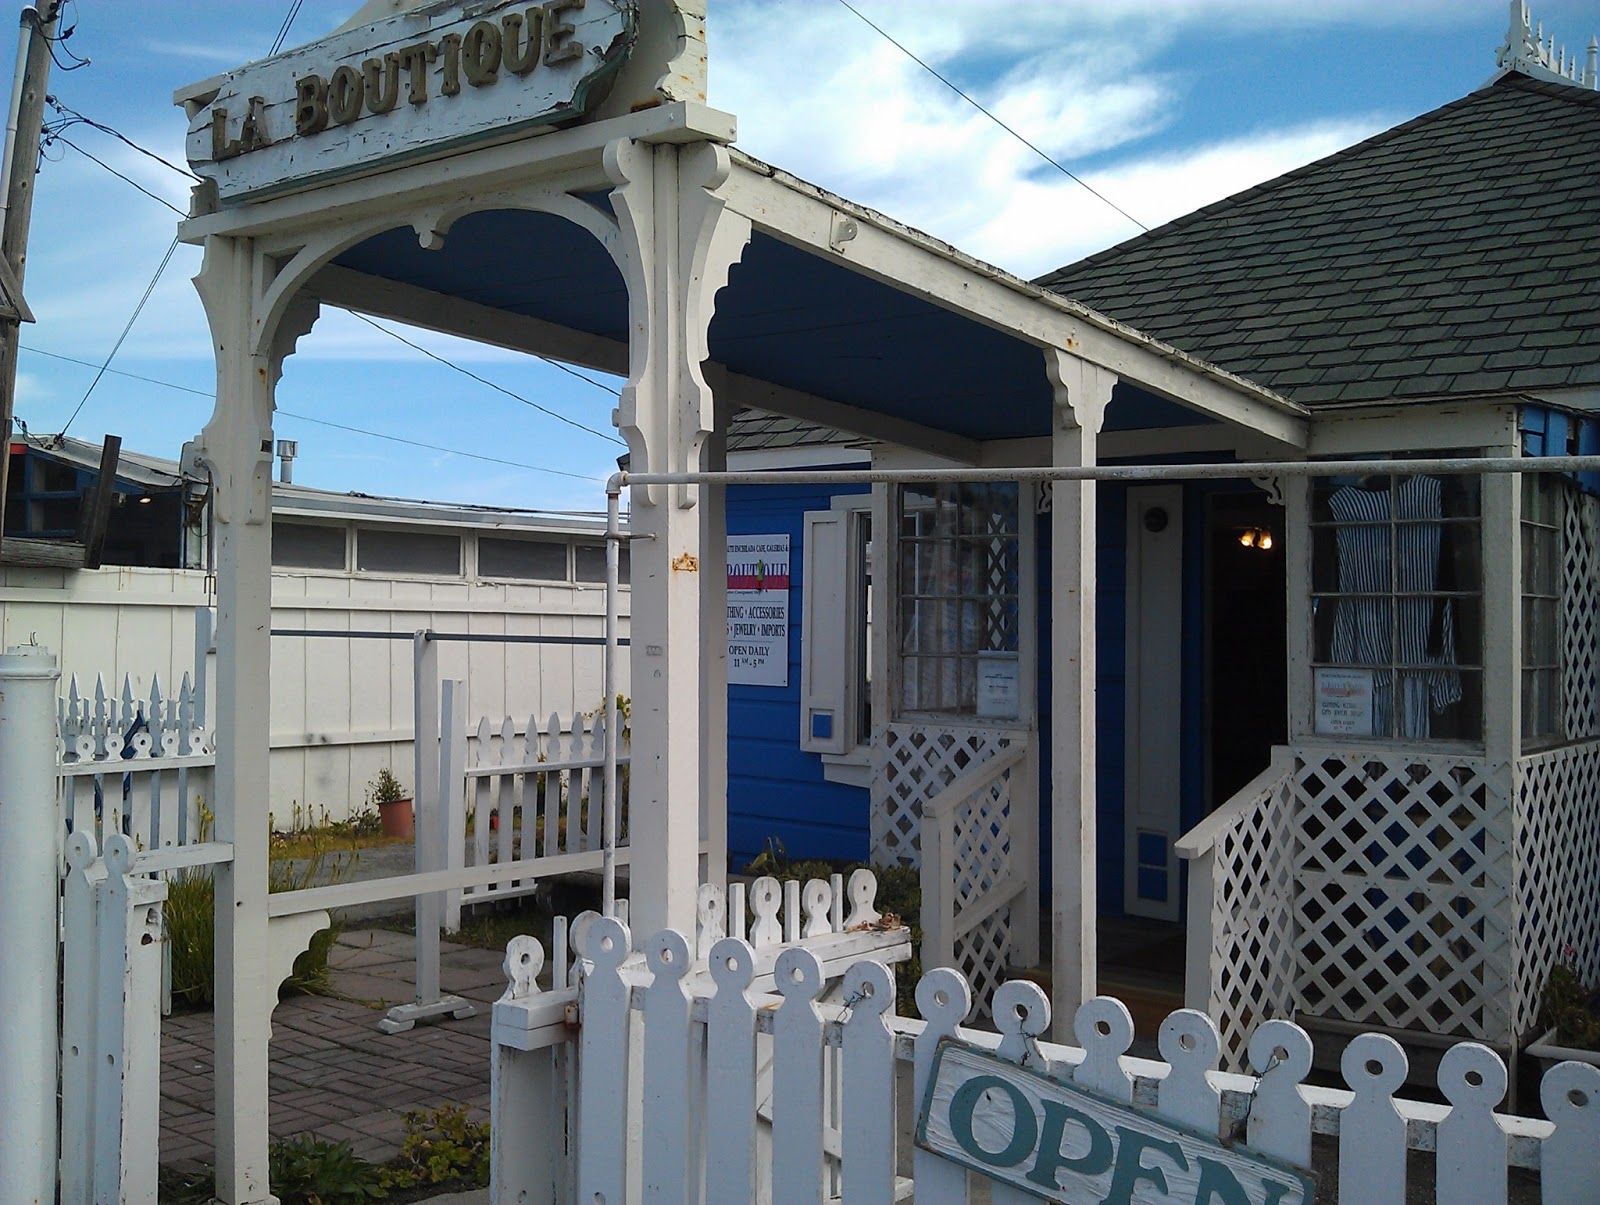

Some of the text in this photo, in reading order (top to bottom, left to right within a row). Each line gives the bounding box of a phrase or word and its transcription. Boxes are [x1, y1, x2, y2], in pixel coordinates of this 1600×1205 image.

[211, 0, 587, 162] LA BOUTIQUE
[748, 606, 785, 620] ACCESSORIES
[733, 624, 756, 639] JEWELRY
[761, 624, 786, 637] IMPORTS
[728, 645, 770, 657] OPEN DAILY
[733, 658, 741, 668] 11
[752, 658, 757, 669] 5
